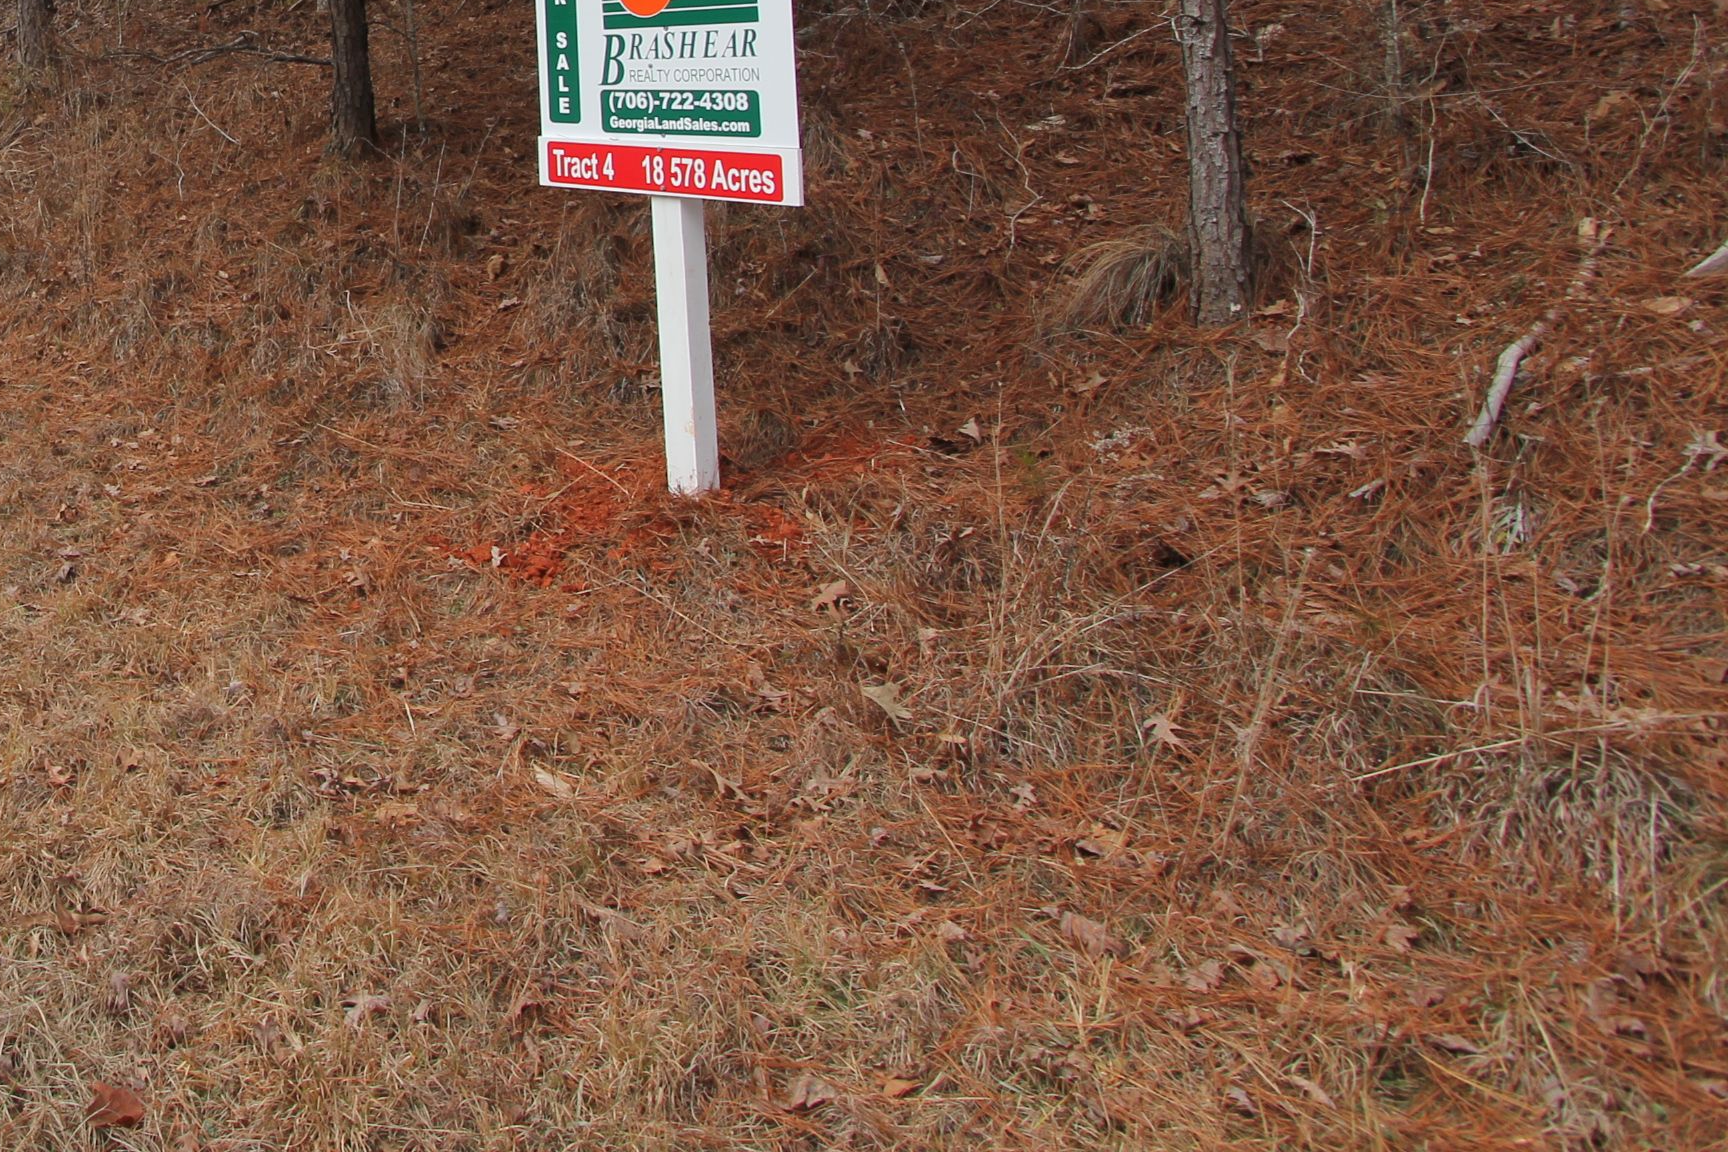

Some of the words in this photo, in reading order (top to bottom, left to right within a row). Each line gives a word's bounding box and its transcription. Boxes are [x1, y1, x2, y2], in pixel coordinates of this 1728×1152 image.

[556, 32, 570, 114] SALE
[598, 28, 758, 86] BRASHEAR
[629, 68, 670, 83] REALTY
[674, 67, 760, 83] CORPORATION
[609, 91, 749, 114] (706)-722-4308
[609, 116, 750, 133] GeorgiaLandSales.com
[552, 149, 599, 180] Tract
[602, 153, 615, 181] 4
[642, 155, 665, 186] 18
[670, 157, 706, 189] 578
[711, 160, 775, 194] Acres
